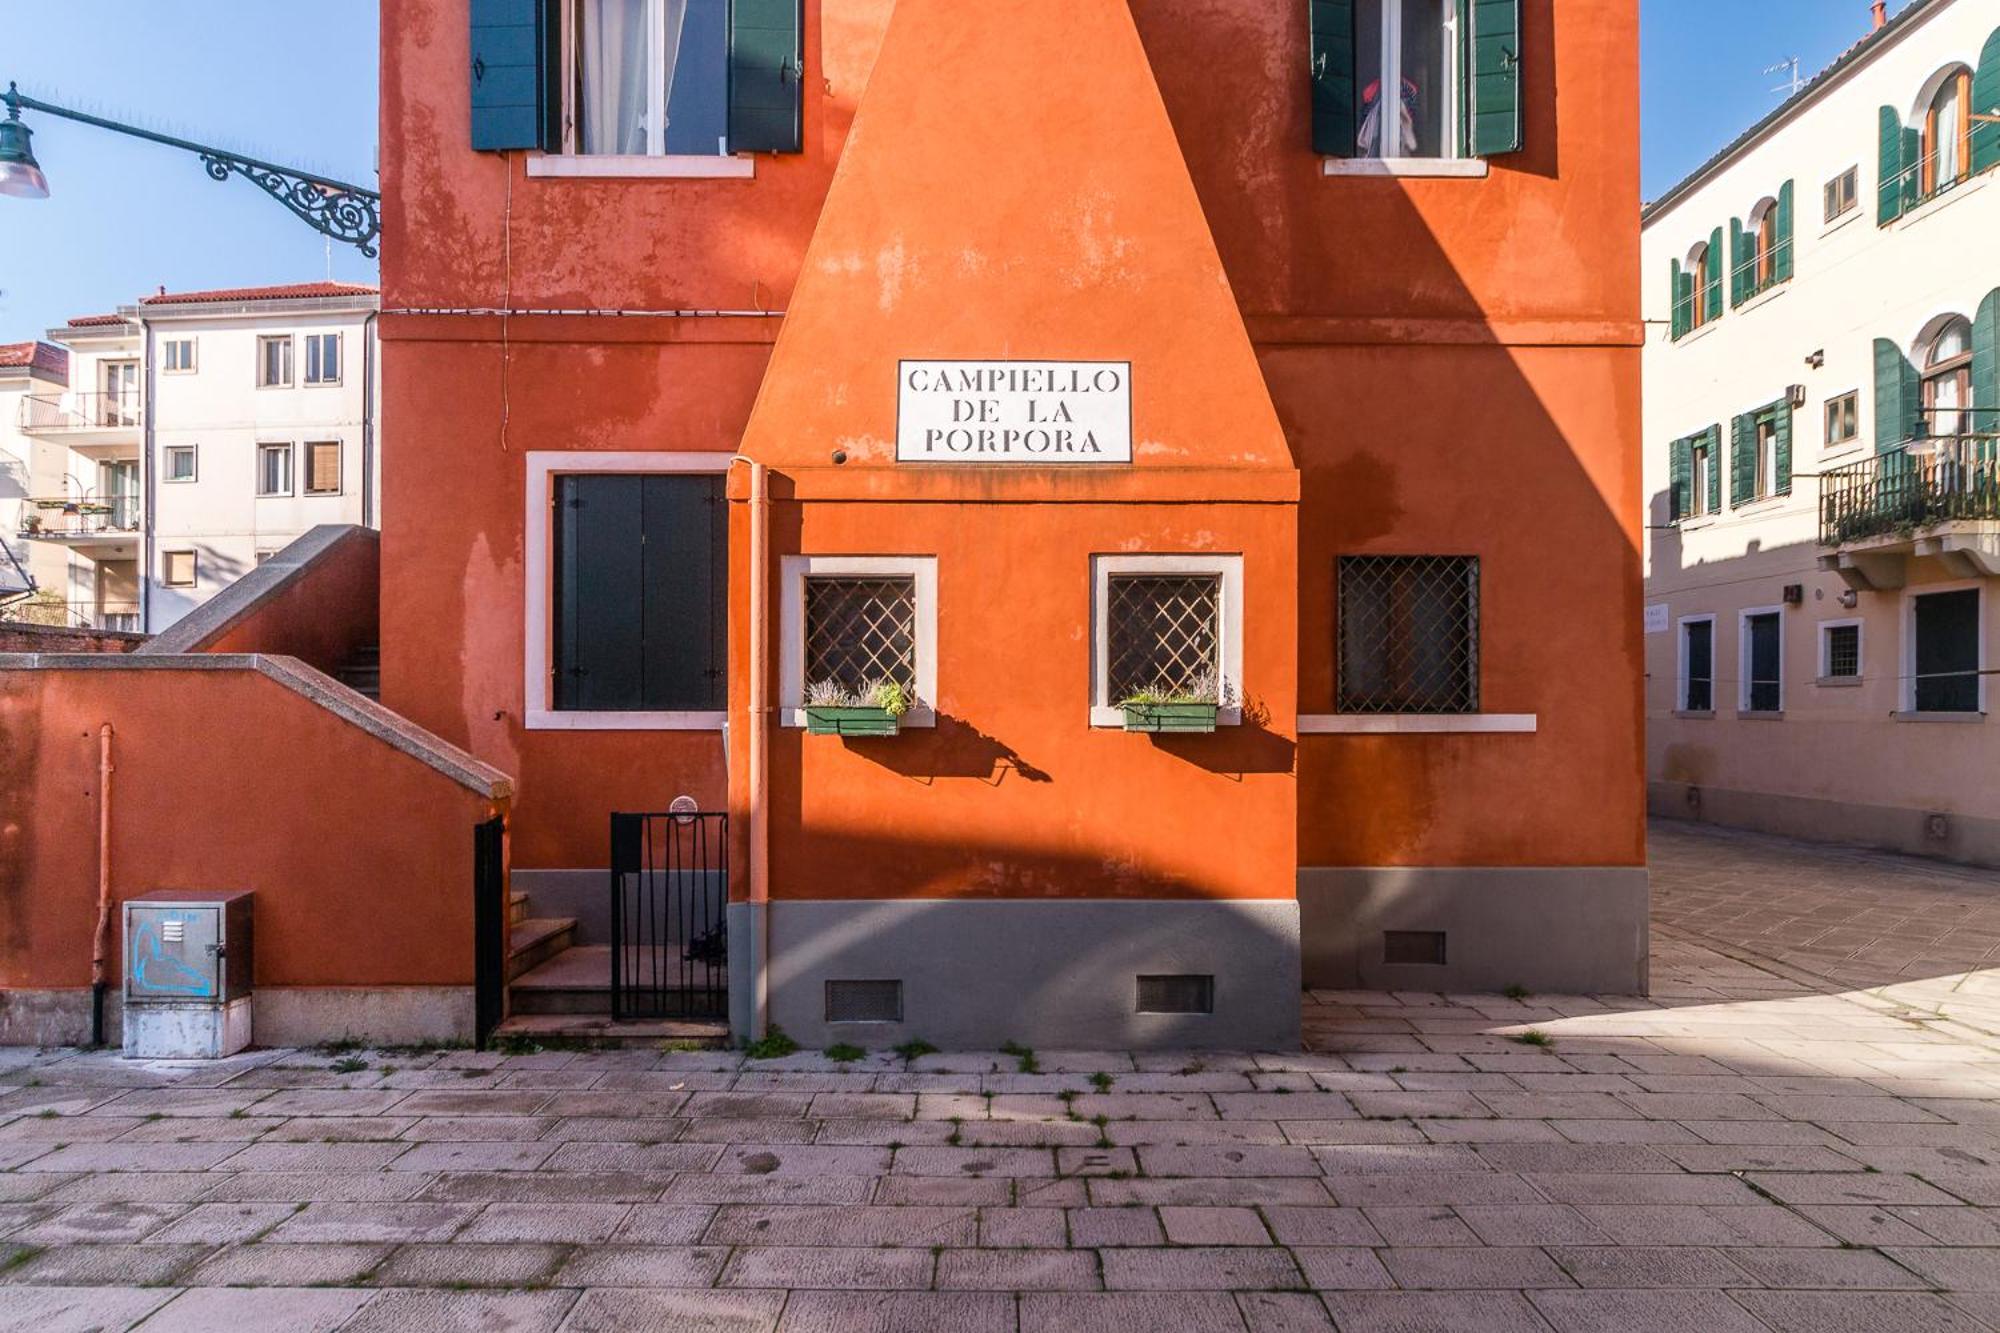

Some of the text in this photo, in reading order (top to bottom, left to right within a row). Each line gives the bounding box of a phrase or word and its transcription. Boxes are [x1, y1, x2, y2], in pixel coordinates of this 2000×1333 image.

[909, 369, 1120, 392] CAMPIELLO
[953, 399, 1073, 422] DE LA
[926, 429, 1102, 452] PORPORA
